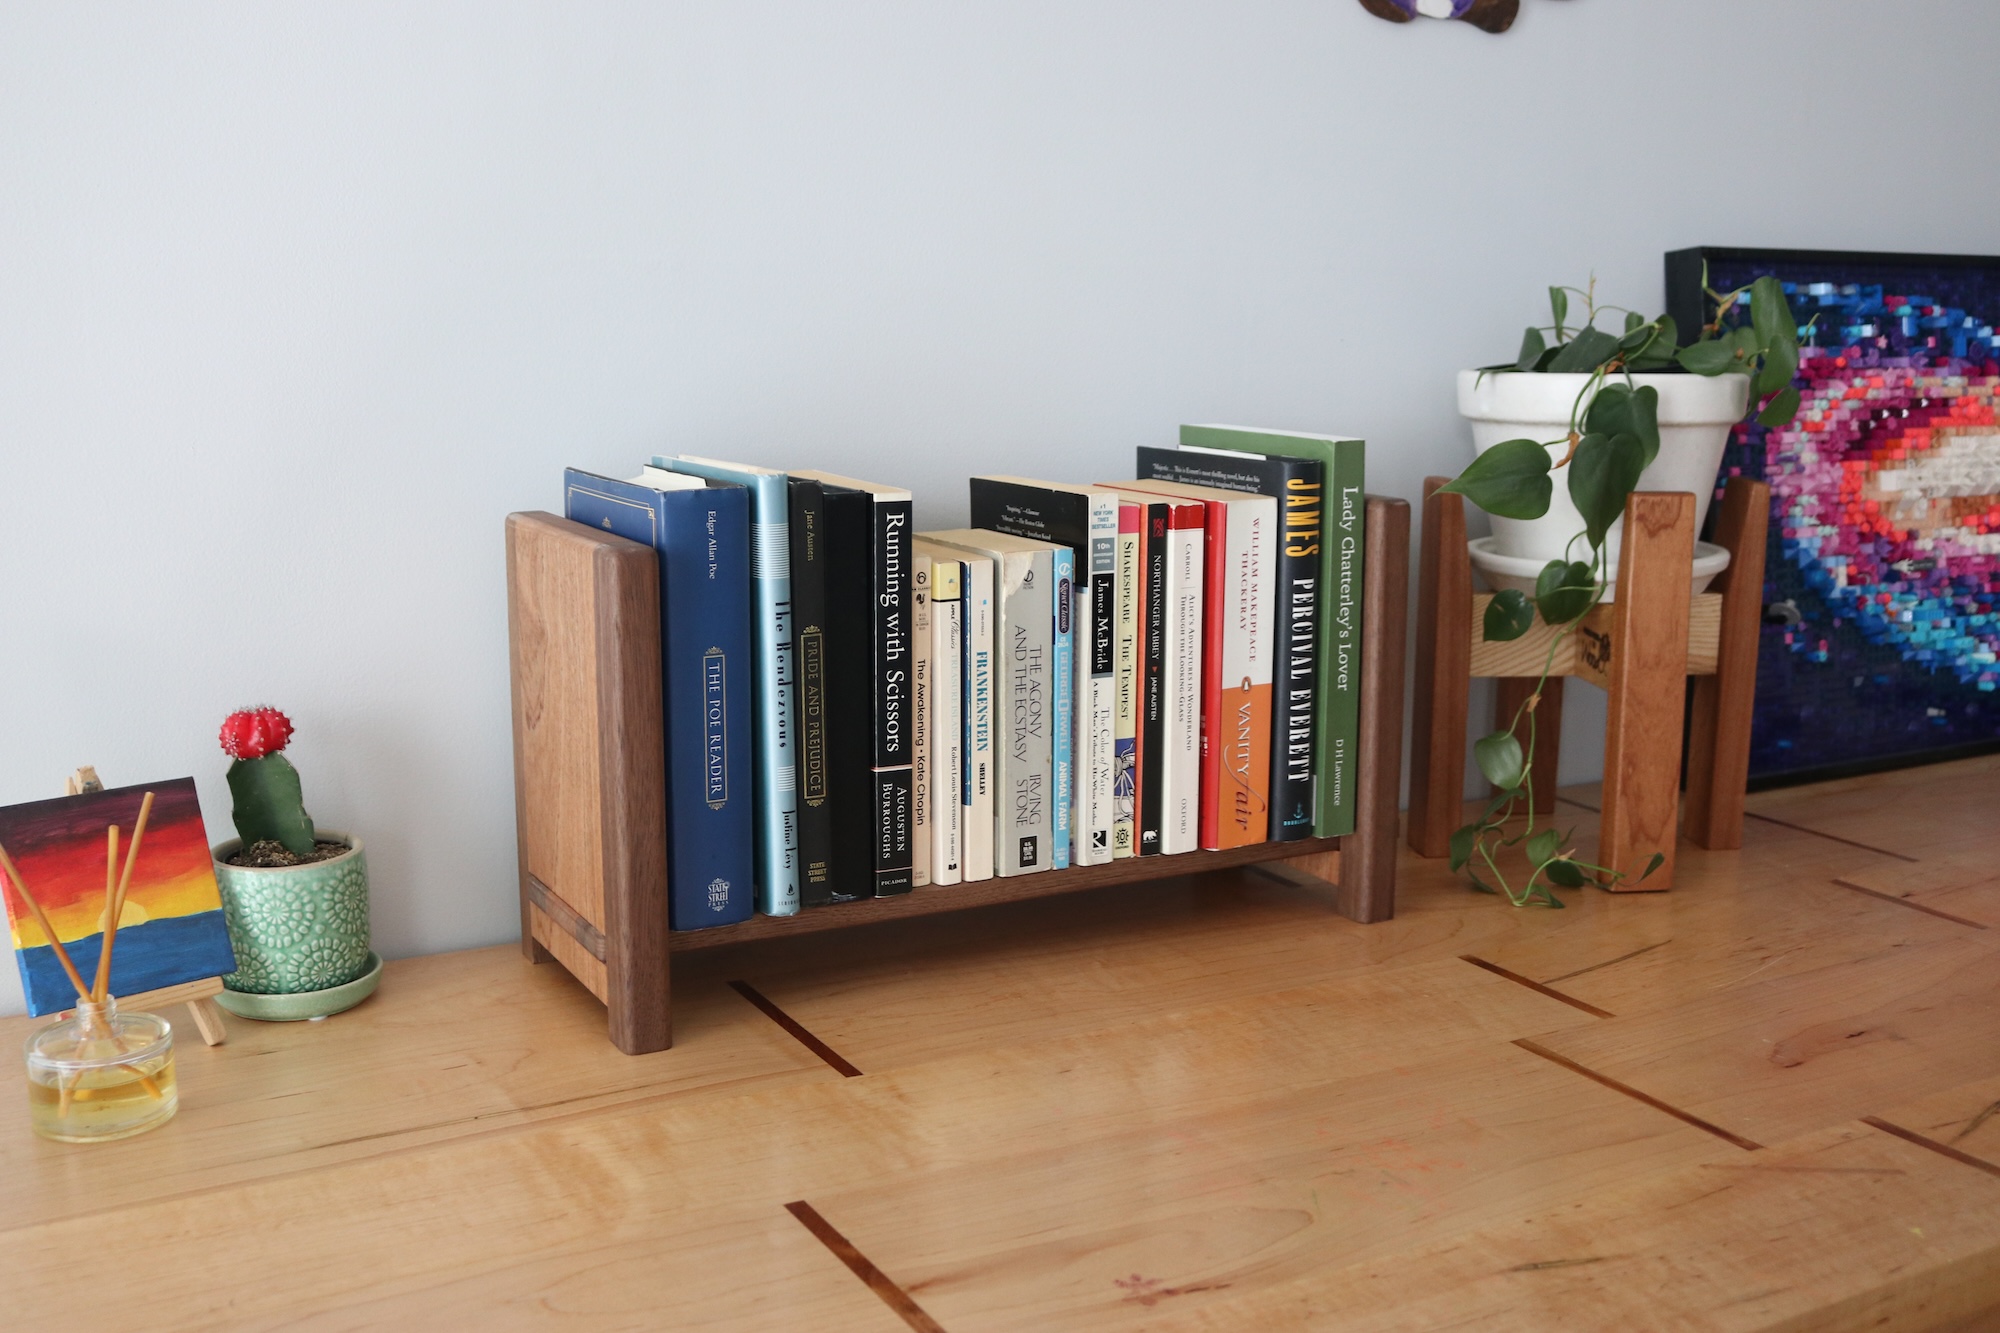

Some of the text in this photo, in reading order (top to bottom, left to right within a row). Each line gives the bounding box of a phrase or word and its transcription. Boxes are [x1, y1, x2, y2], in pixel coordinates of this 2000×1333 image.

[706, 510, 718, 579] Edgar Allan Poe
[804, 510, 816, 561] Jane Austen
[1097, 542, 1110, 550] 10th
[1286, 478, 1320, 557] JAMES
[1097, 580, 1108, 670] James McBride
[1152, 555, 1162, 660] NORTHANGER ABBEY
[1188, 594, 1196, 625] ALICE'S
[1239, 550, 1248, 630] THACKERAY
[1249, 518, 1260, 662] WILLIAM MAKEPEACE
[1336, 487, 1358, 691] Lady Chatterley's Lover
[880, 512, 905, 752] Running with Scissors
[951, 618, 961, 649] Classics
[1121, 542, 1133, 720] SHAKESPEARE THE TEMPEST
[776, 602, 793, 748] The Rendezvous
[915, 659, 926, 747] The Awakening
[977, 651, 988, 751] FRANKENSTEIN
[1013, 625, 1027, 762] AND THE ECSTASY
[1028, 645, 1041, 738] THE AGONY
[1288, 578, 1314, 782] PERCIVAL EVERETT
[708, 662, 722, 794] THE POE READER
[808, 642, 821, 791] PRIDE AND PREJUDICE
[1098, 707, 1110, 796] The Color of Water
[1186, 694, 1194, 750] WONDERLAND
[1237, 702, 1250, 778] VANITY
[915, 756, 926, 826] Kate Chopin
[1016, 779, 1028, 828] STONE
[1029, 774, 1041, 825] IRVING
[1059, 762, 1068, 830] ANIMAL FARM
[1224, 744, 1265, 830] Fair
[1334, 739, 1344, 806] D H Lawrence
[782, 810, 797, 869] Justine Lévy
[882, 783, 893, 859] BURROUGHS
[896, 787, 907, 851] AUGUSTEN
[708, 883, 726, 893] STATE
[708, 893, 728, 902] STREET
[881, 878, 908, 886] PICADOR
